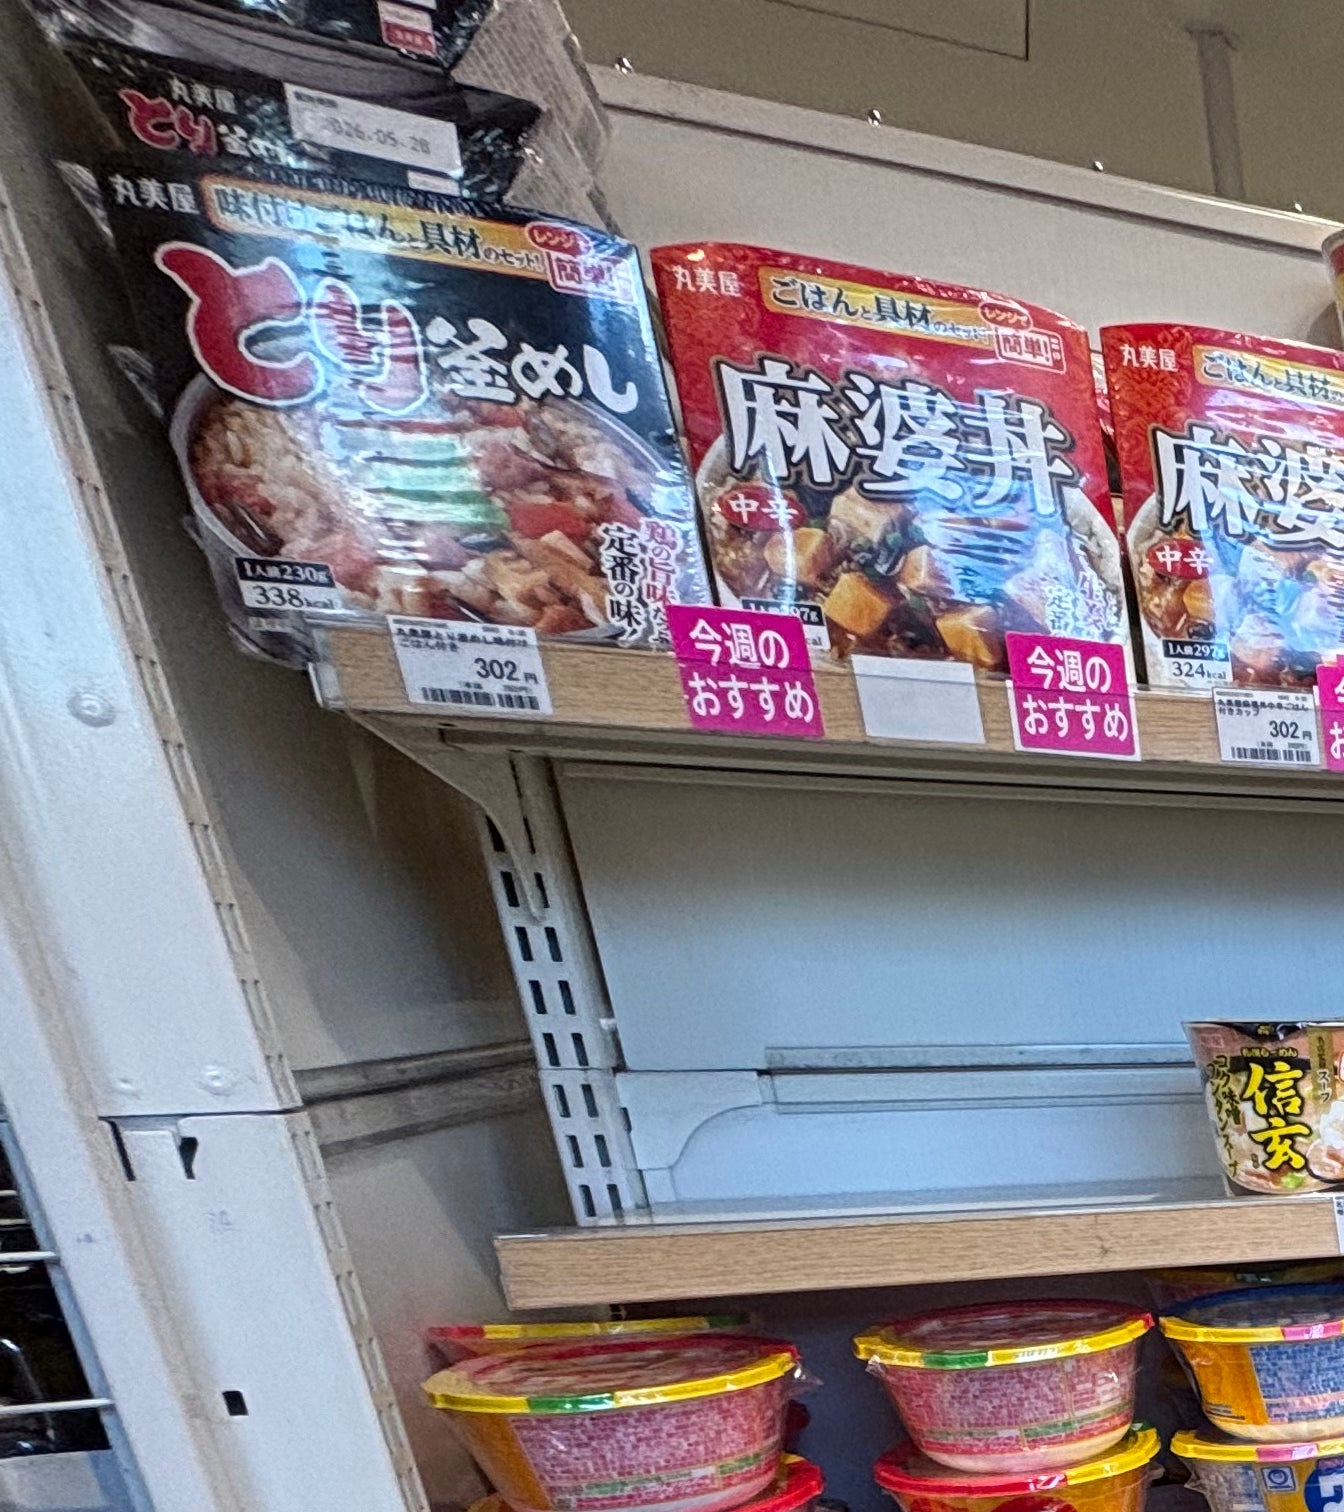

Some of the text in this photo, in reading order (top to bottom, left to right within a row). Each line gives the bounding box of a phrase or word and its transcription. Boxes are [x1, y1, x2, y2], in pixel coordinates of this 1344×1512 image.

[109, 173, 196, 213] 丸美屋
[673, 266, 742, 298] 丸美屋
[1122, 346, 1179, 372] 丸美屋
[729, 492, 798, 526] 中辛
[1157, 545, 1213, 574] 中辛
[689, 618, 790, 669] 今週の
[1027, 645, 1112, 693] 今週の
[1172, 661, 1227, 680] 324kcal
[689, 672, 814, 722] おすすめ
[1022, 697, 1129, 741] おすすめ
[1245, 1061, 1310, 1170] 信玄
